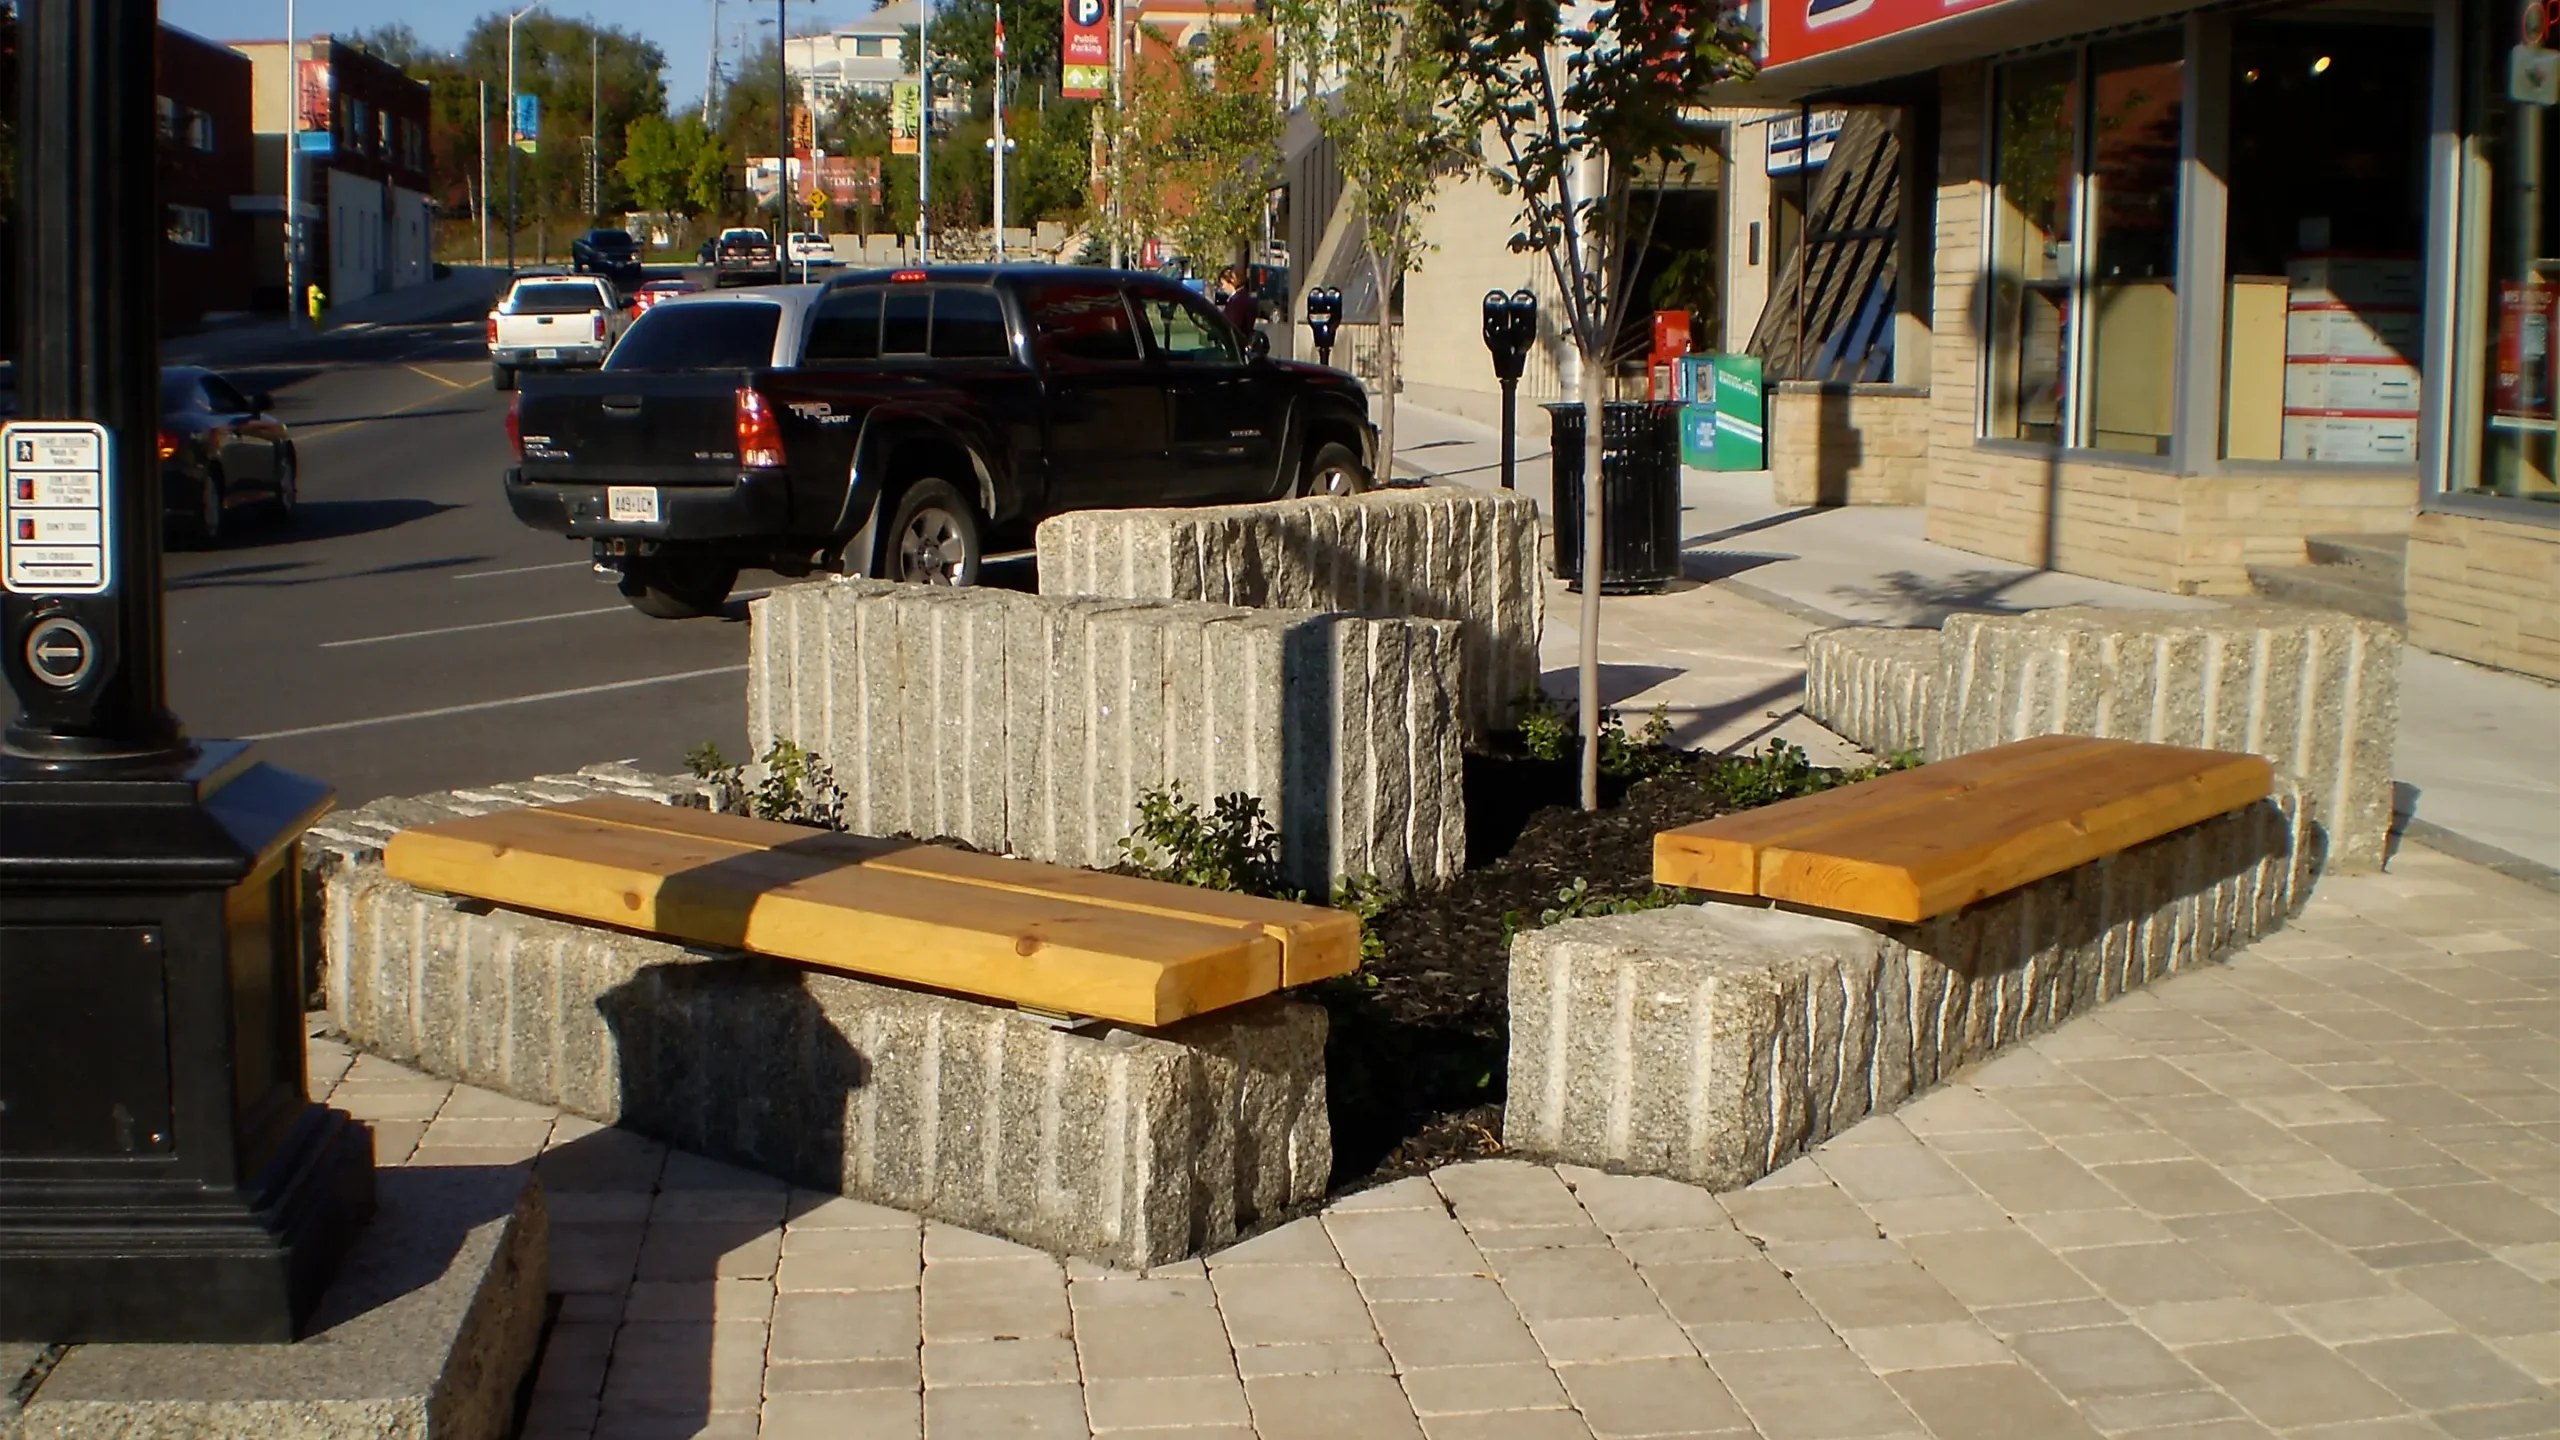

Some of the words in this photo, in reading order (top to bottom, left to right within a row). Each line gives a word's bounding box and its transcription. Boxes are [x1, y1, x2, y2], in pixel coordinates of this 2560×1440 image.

[1079, 0, 1099, 22] P
[1074, 34, 1099, 44] Public
[1071, 43, 1102, 55] Parking
[820, 414, 852, 424] SPORT
